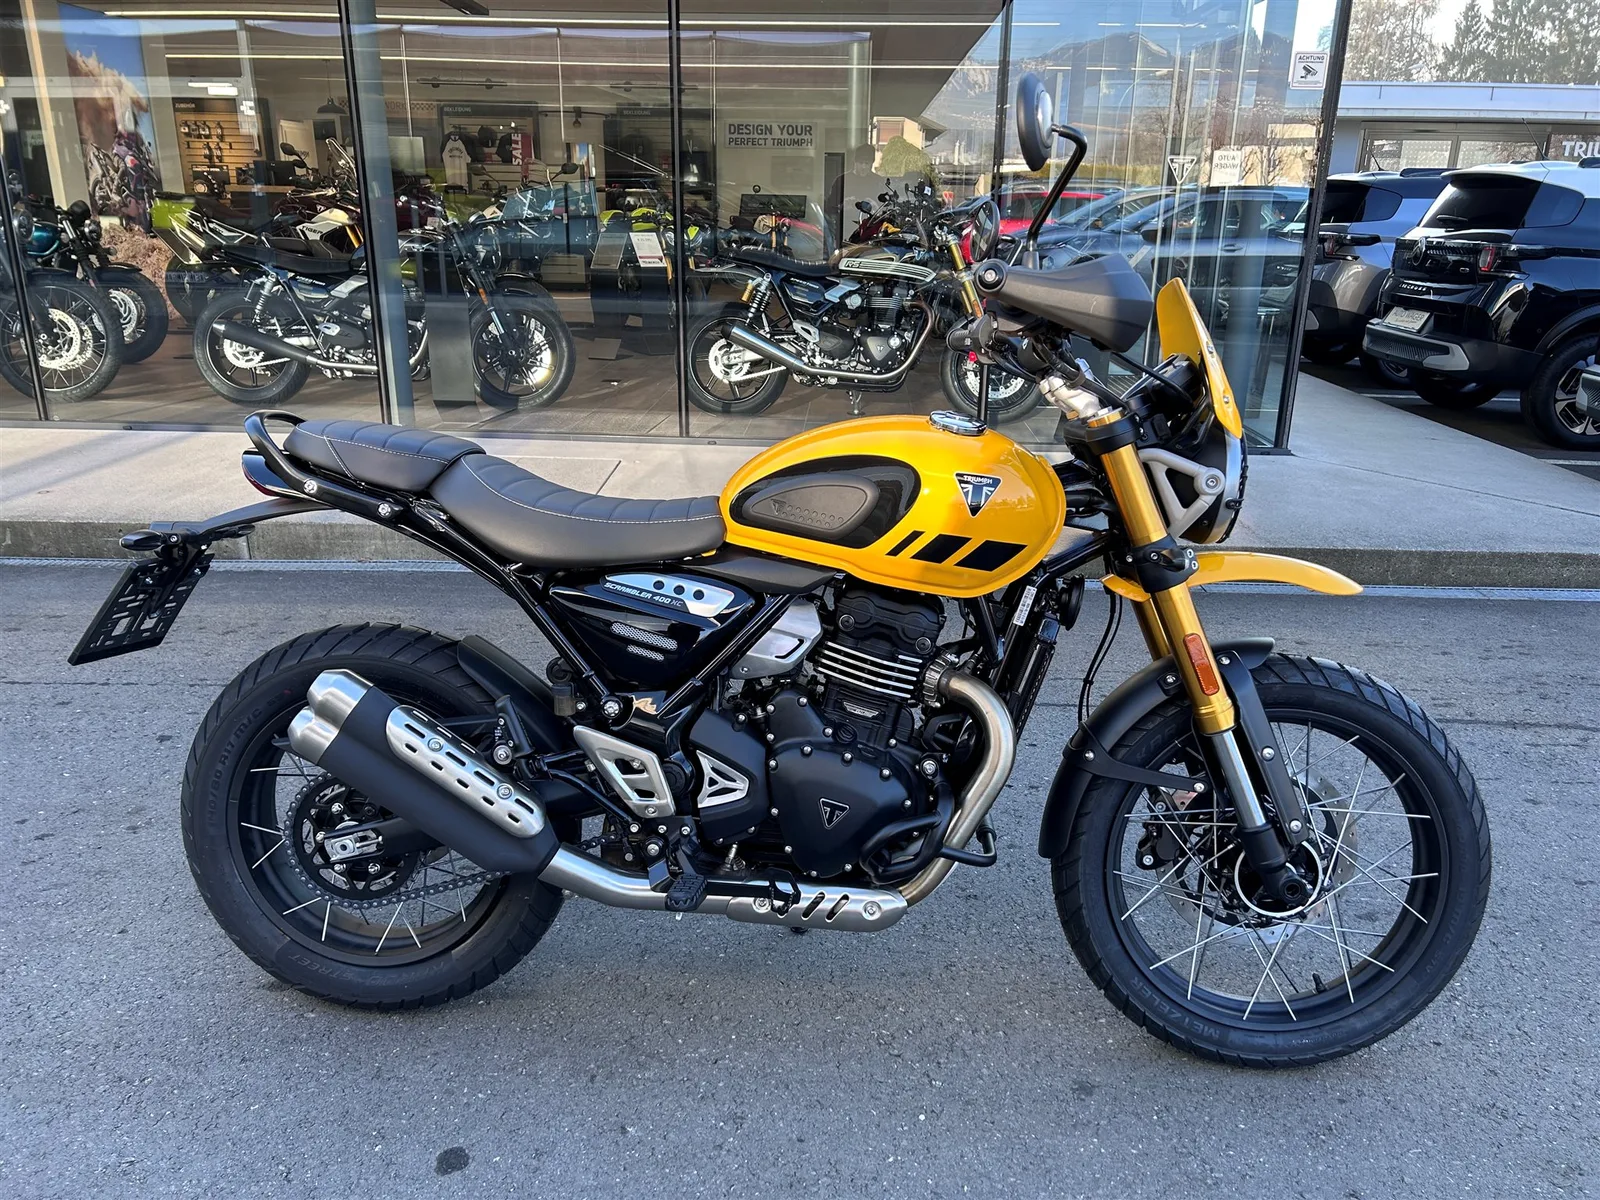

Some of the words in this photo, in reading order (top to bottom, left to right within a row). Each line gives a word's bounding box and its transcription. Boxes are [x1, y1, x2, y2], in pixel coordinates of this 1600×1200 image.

[728, 123, 773, 136] DESIGN
[777, 124, 813, 136] YOUR
[511, 133, 523, 166] SALE
[728, 137, 768, 147] PERFECT
[771, 138, 813, 147] TRIUMPH
[845, 259, 861, 268] RS
[963, 475, 993, 485] TRIUMPH
[604, 582, 653, 600] SCRAMBLER
[653, 595, 672, 604] 400
[671, 599, 684, 607] XC
[289, 953, 355, 982] STREET
[1129, 975, 1221, 1039] METZELER
